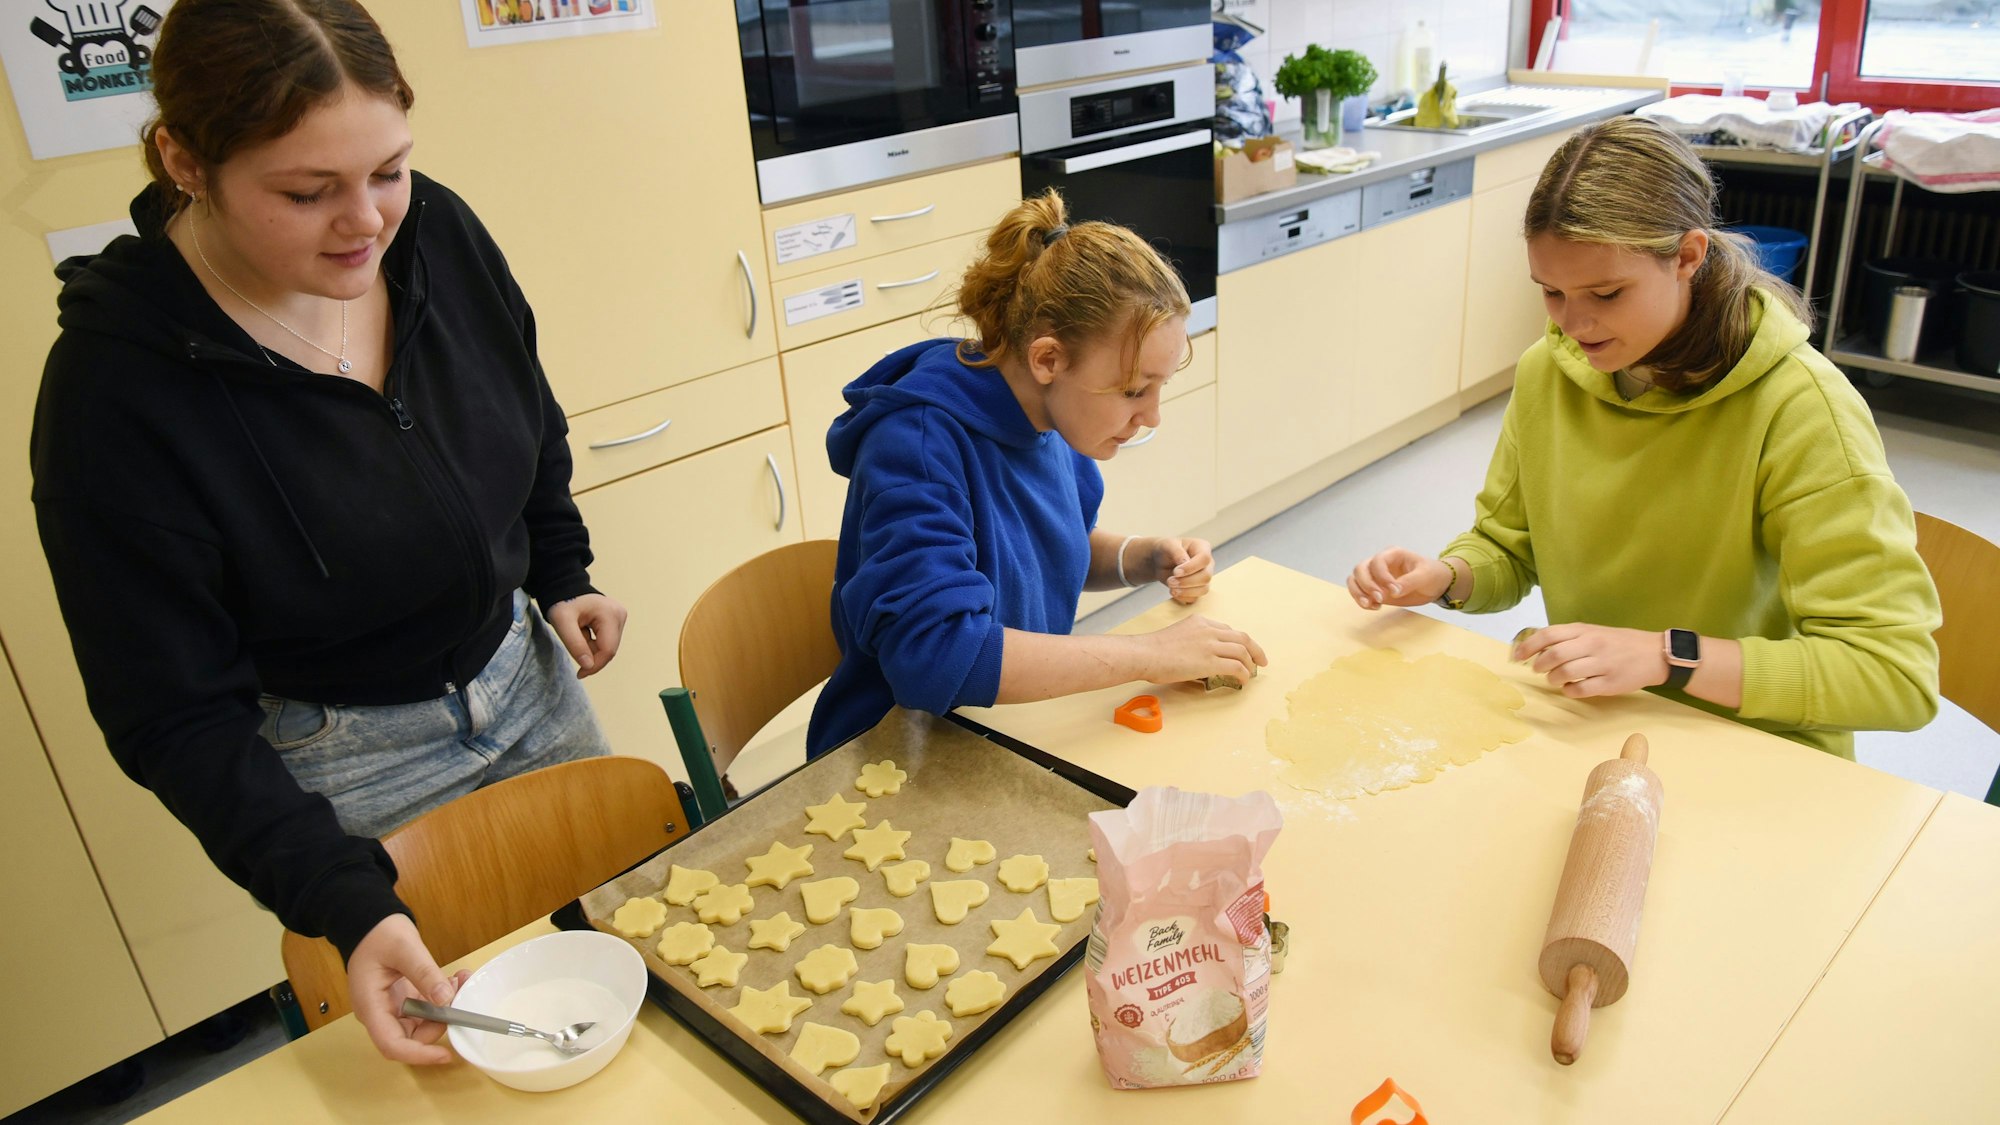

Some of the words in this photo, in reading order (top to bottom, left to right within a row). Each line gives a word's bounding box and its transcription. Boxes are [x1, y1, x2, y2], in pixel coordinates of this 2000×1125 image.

[84, 50, 126, 66] Food
[1146, 928, 1185, 951] Family
[1149, 920, 1177, 939] Back
[1111, 943, 1225, 990] WEIZENMEHL
[1154, 982, 1173, 997] TYPE
[1174, 974, 1191, 987] 405
